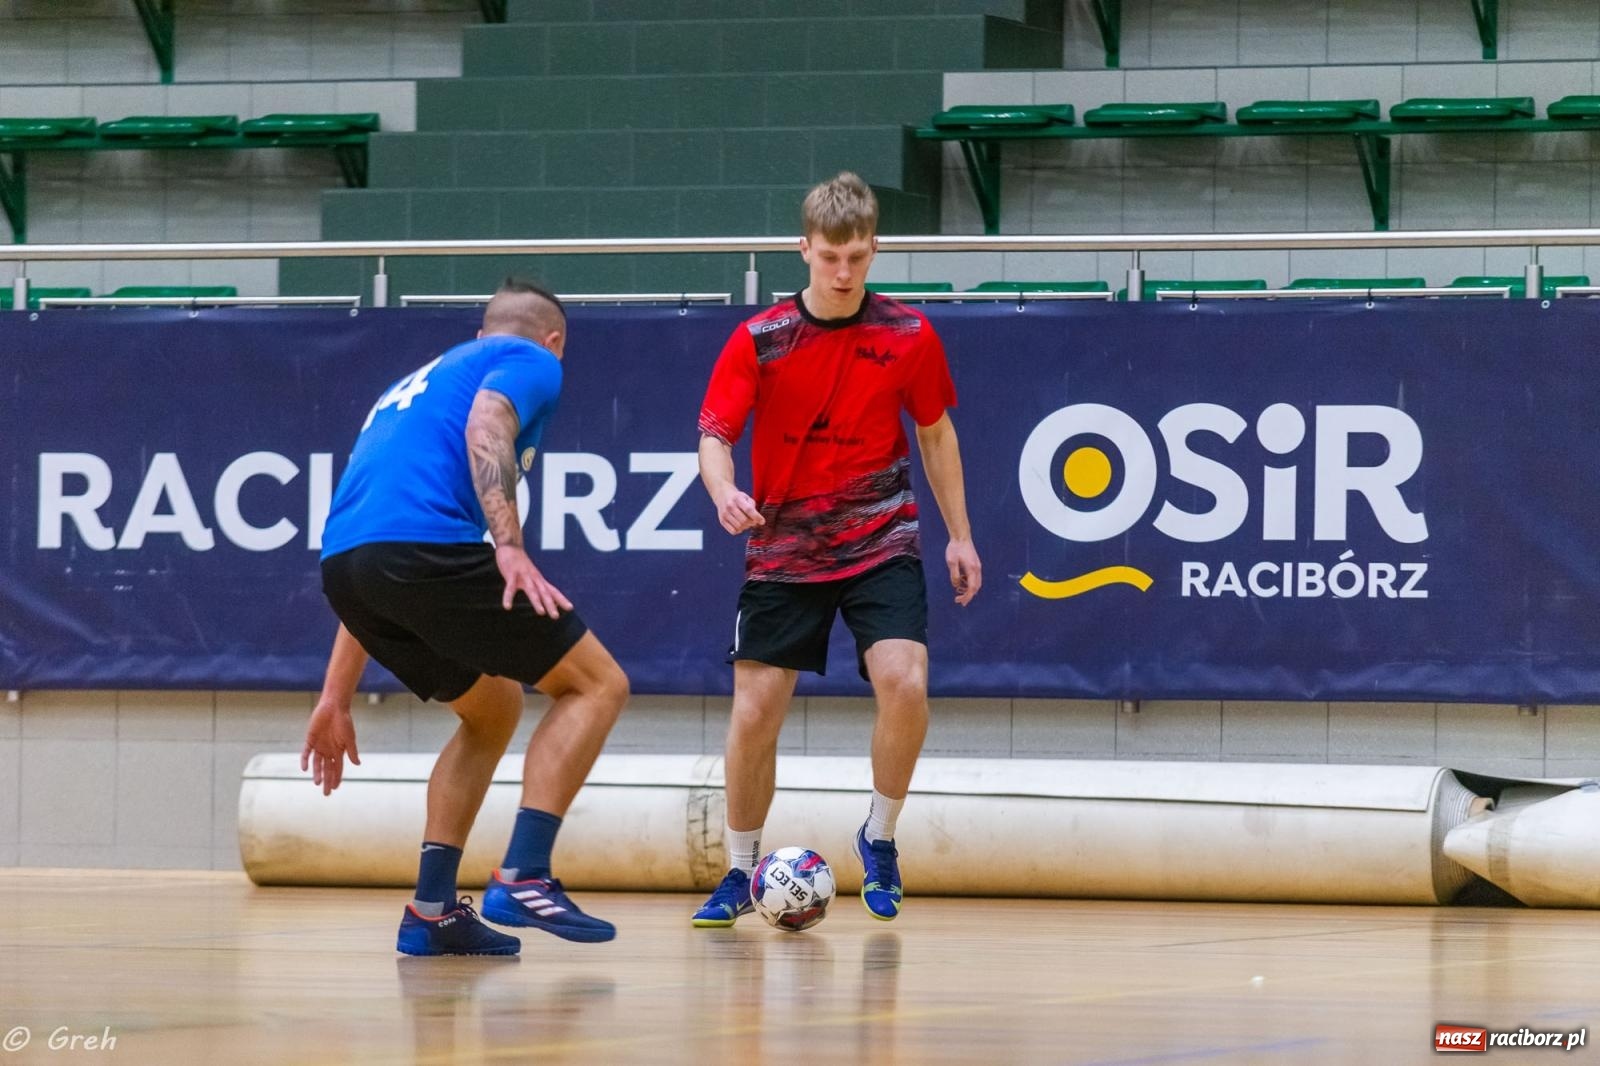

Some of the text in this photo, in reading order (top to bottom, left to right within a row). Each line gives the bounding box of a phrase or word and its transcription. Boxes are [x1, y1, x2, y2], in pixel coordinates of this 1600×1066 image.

[762, 318, 790, 333] COLO
[37, 450, 704, 552] RACIRZ
[1181, 549, 1429, 599] RACIBÓRZ
[770, 867, 808, 902] SELECT
